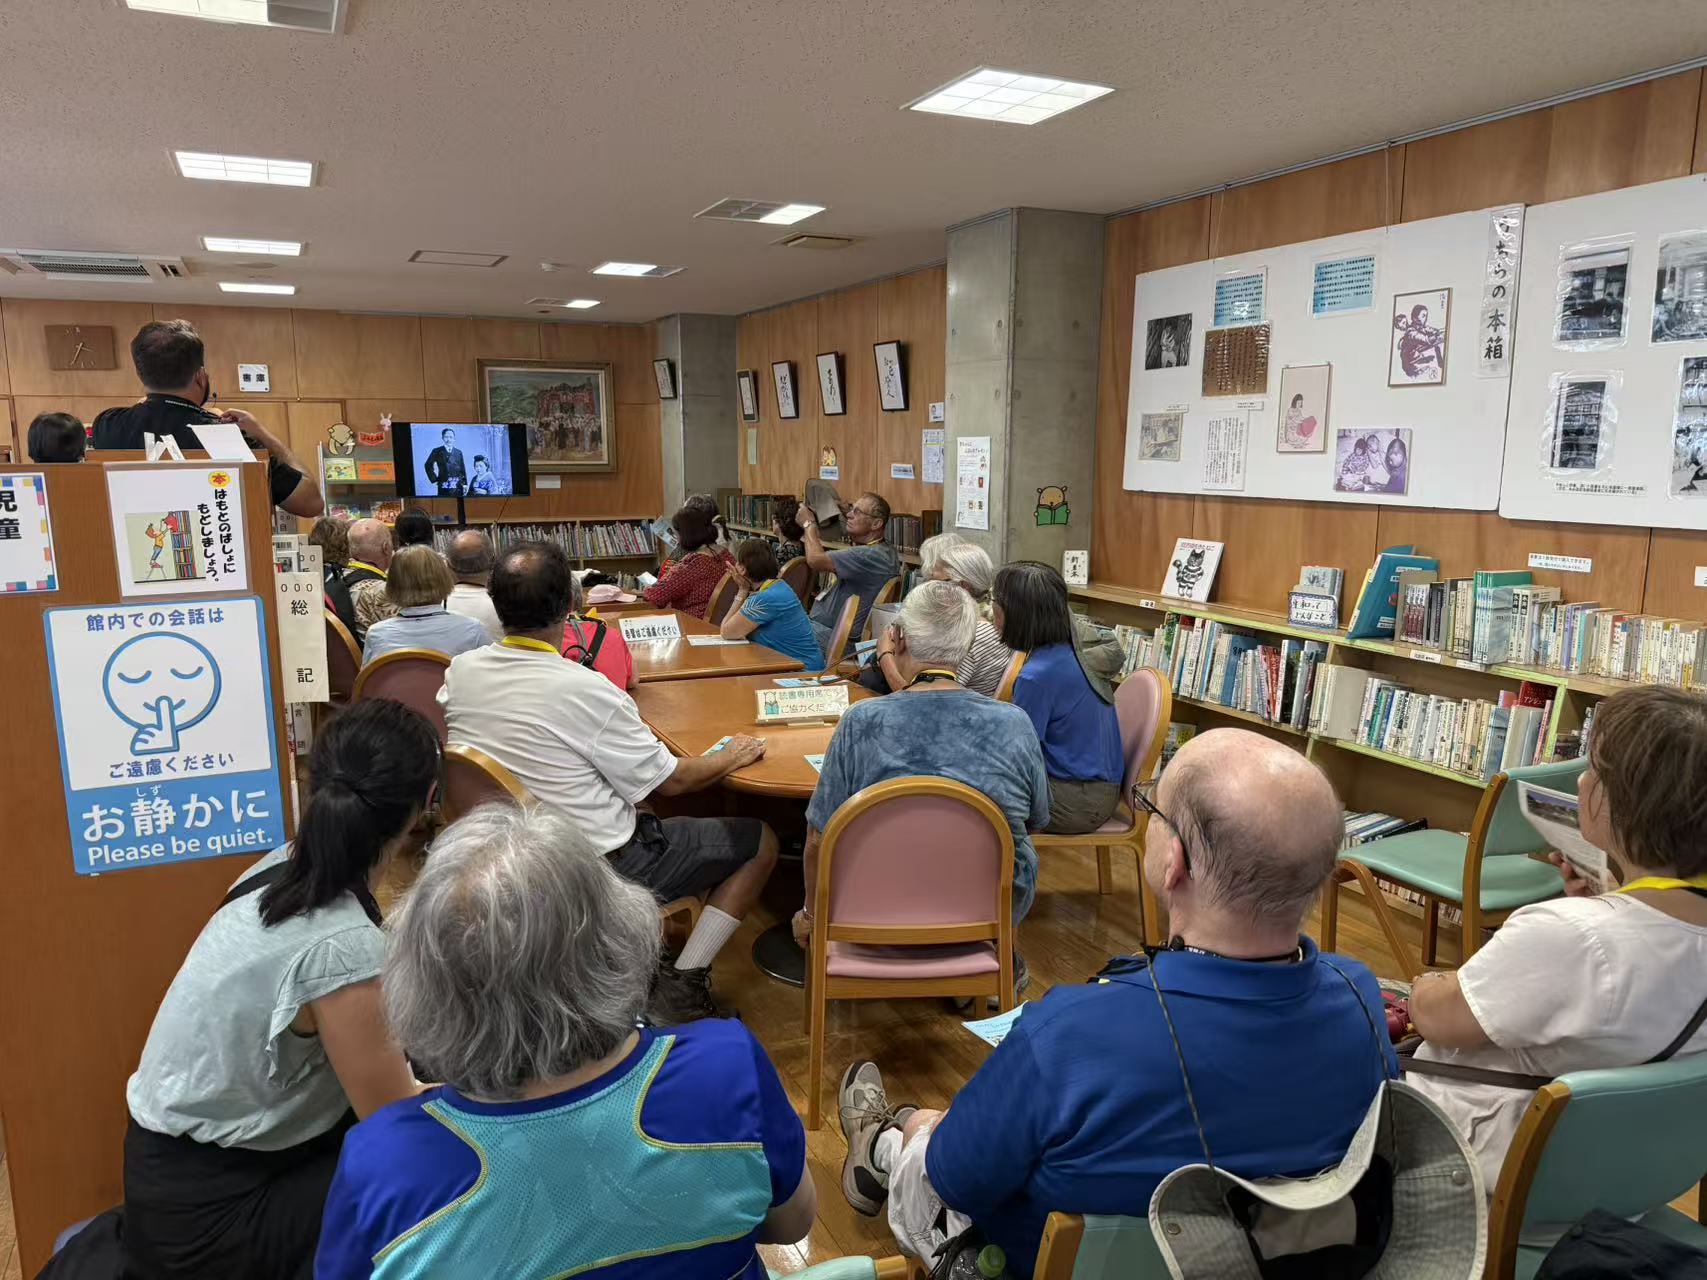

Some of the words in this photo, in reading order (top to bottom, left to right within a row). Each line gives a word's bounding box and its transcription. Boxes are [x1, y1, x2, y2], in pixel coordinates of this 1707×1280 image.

[197, 503, 219, 582] もとしましょう。
[86, 608, 225, 632] 館内での会話は
[109, 753, 235, 779] ご遠慮ください
[136, 784, 162, 797] しず
[82, 789, 270, 843] お静かに
[87, 842, 165, 866] Please
[171, 835, 200, 855] be
[207, 827, 273, 854] quiet.
